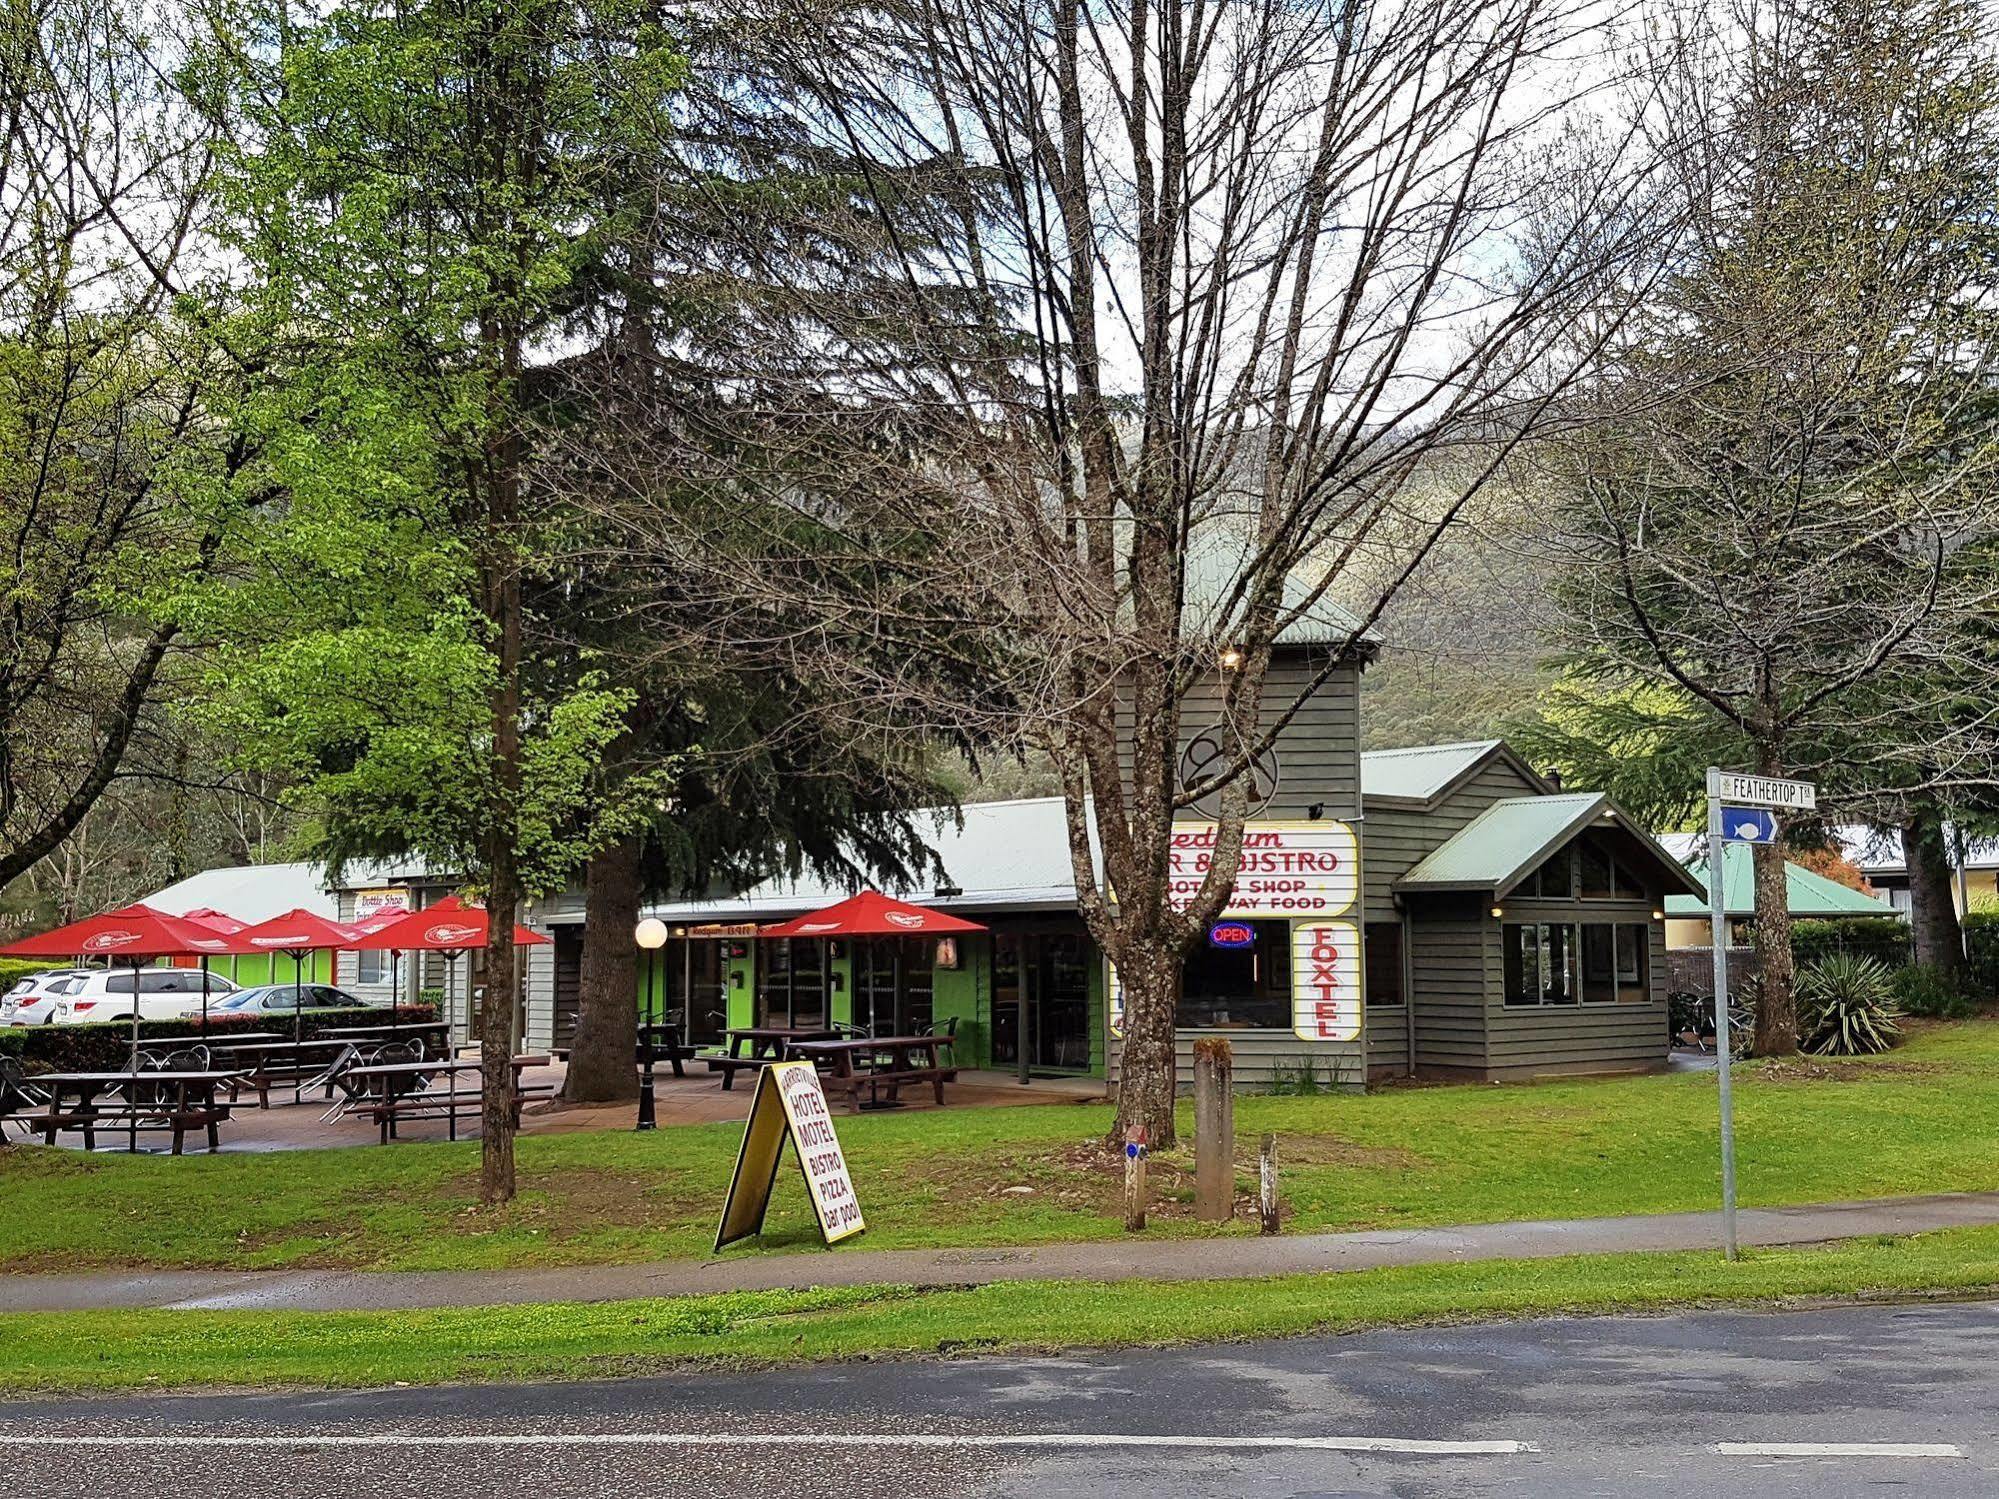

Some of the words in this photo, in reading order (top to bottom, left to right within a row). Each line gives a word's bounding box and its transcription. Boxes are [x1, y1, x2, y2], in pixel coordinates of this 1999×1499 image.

[1733, 778, 1796, 803] FEATHERTOP
[1170, 826, 1283, 849] edum
[1249, 880, 1307, 894] SHOP
[1270, 897, 1326, 910] FOOD
[1213, 927, 1250, 942] OPEN
[1310, 927, 1339, 1038] FOXTEL
[789, 1092, 825, 1119] HOTEL
[797, 1120, 834, 1149] MOTEL
[809, 1151, 842, 1177] BISTRO
[819, 1177, 849, 1202] PIZZA
[821, 1205, 839, 1229] bar
[840, 1194, 861, 1231] pool
